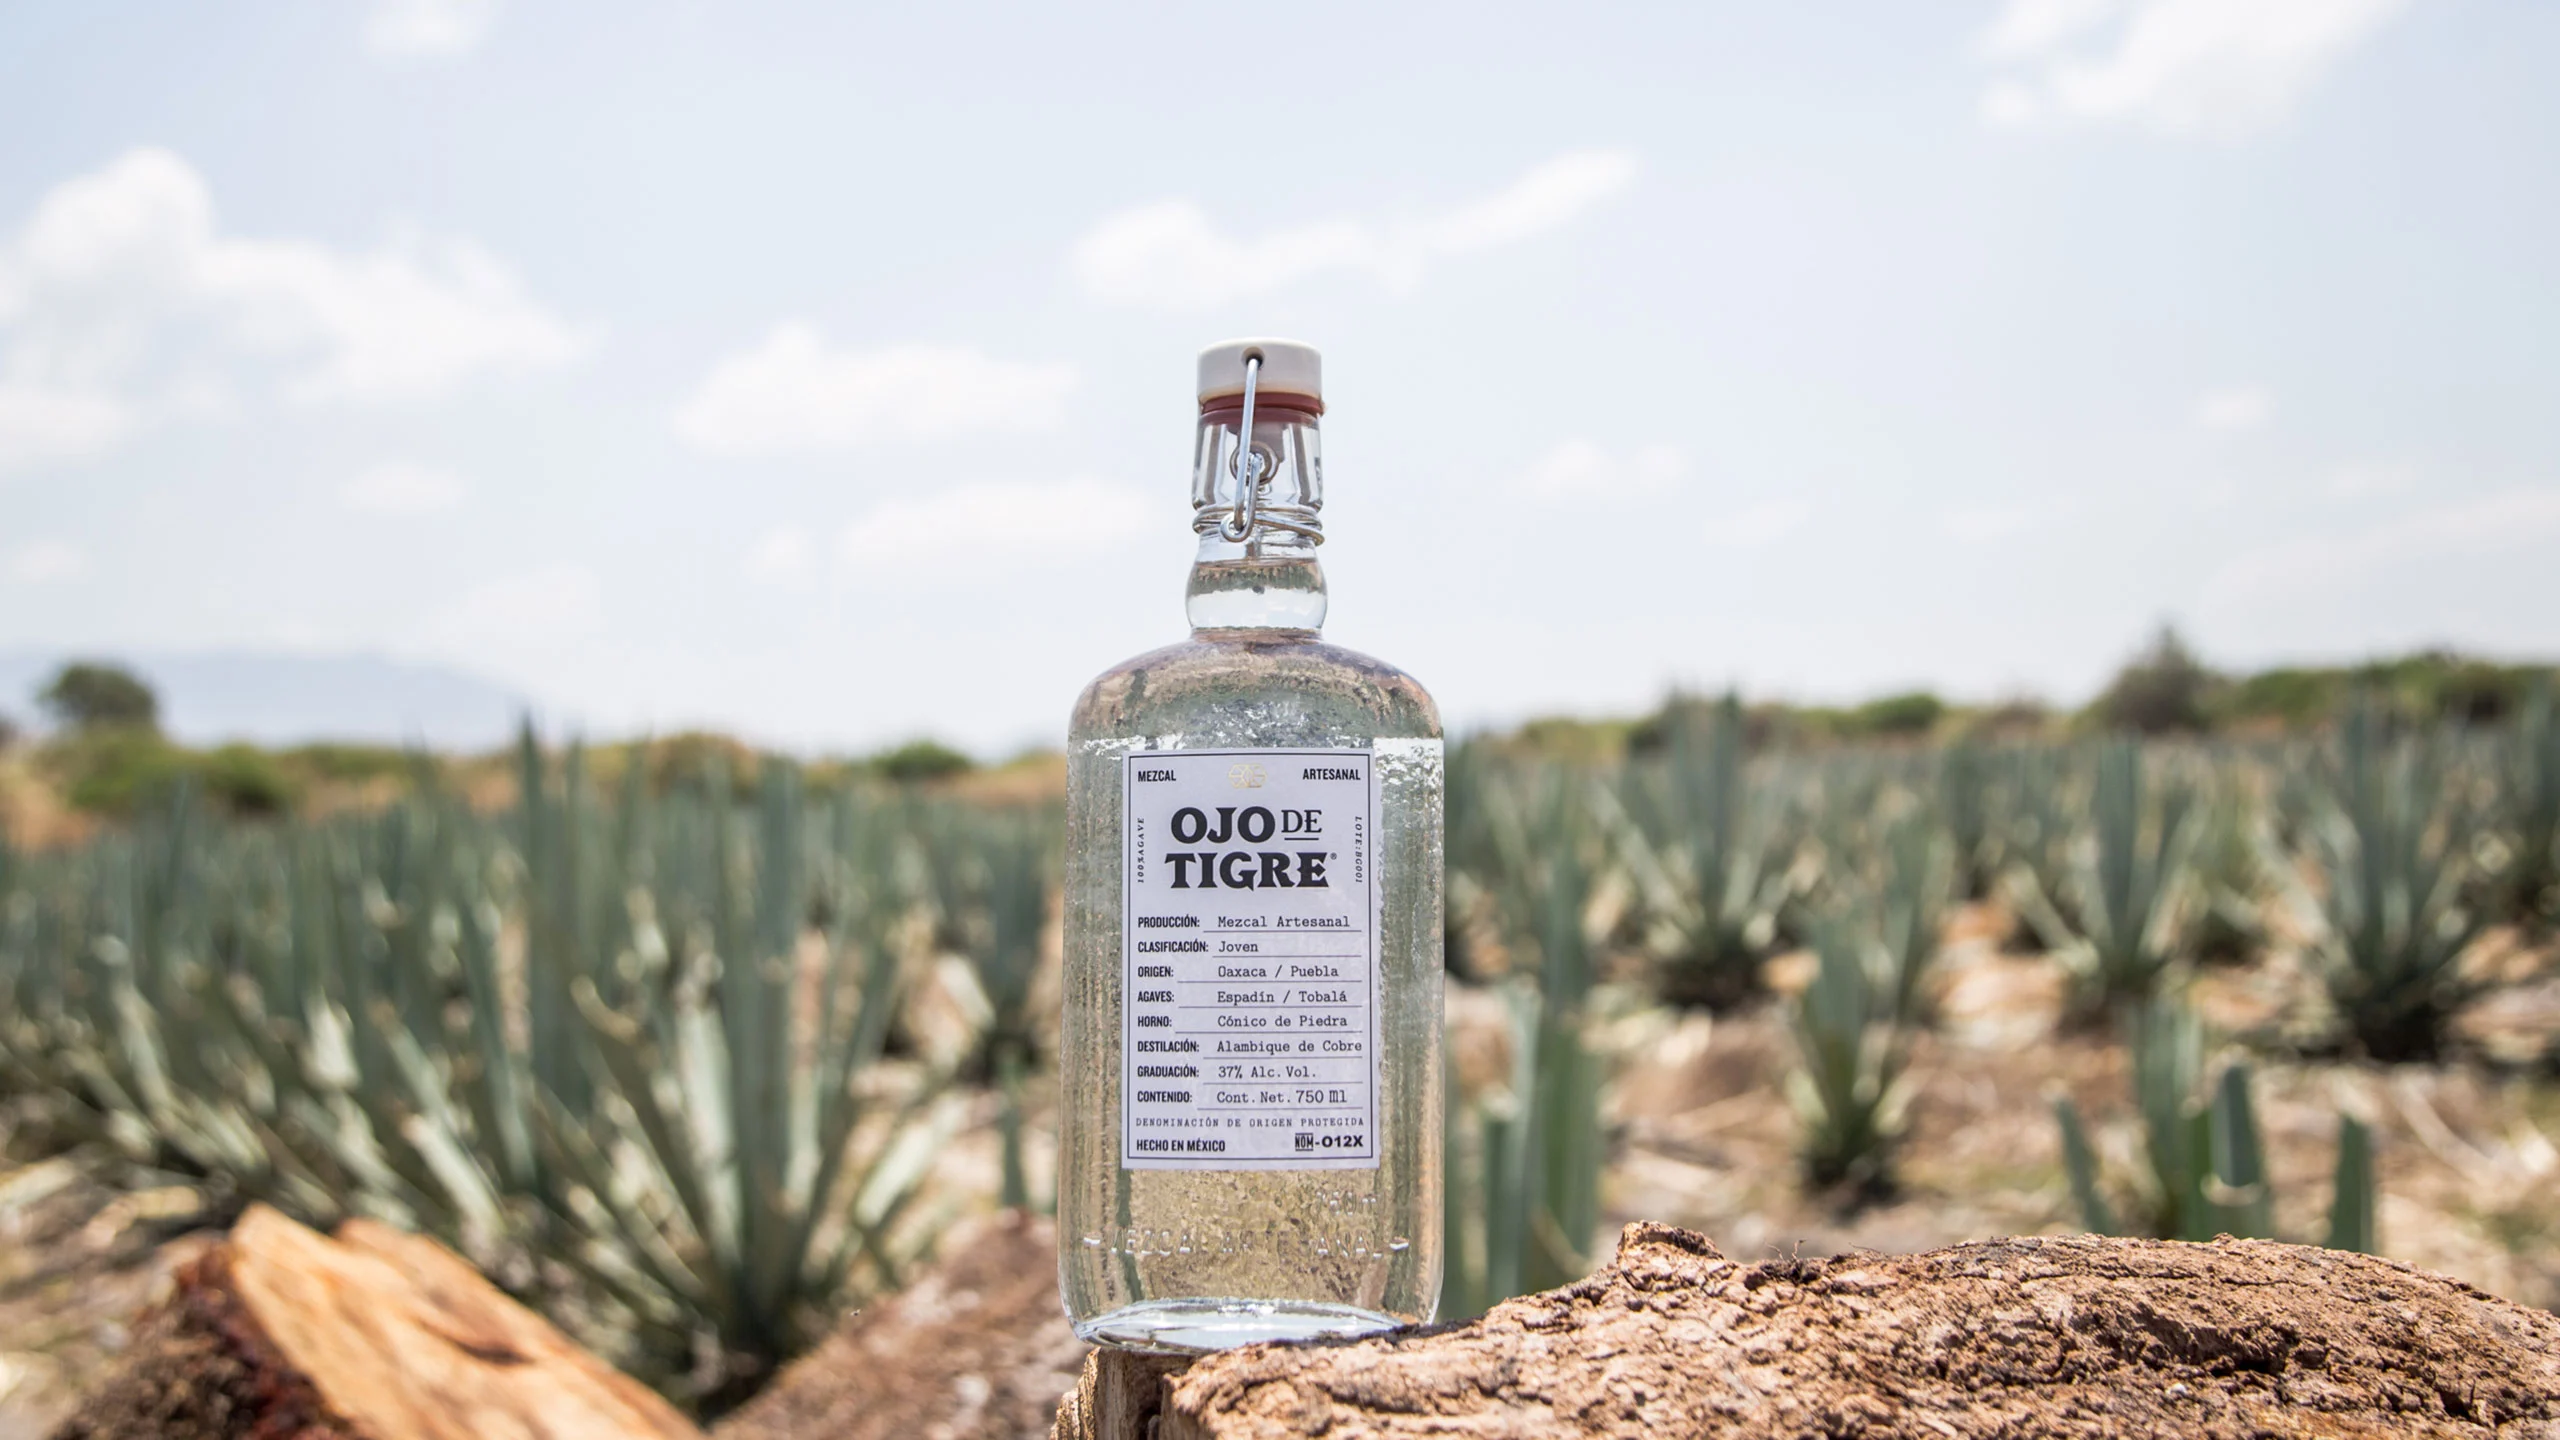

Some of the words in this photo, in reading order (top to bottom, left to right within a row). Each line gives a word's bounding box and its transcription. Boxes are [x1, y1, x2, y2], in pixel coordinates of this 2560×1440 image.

[1137, 769, 1177, 783] MEZCAL
[1302, 767, 1362, 782] ARTESANAL
[1170, 805, 1277, 845] OJO
[1280, 808, 1323, 835] DE
[1137, 914, 1201, 929] PRODUCCIÓN:
[1217, 915, 1269, 929] Mezcal
[1276, 915, 1352, 929] Artesanal
[1137, 938, 1210, 954] CLASIFICACIÓN:
[1218, 940, 1260, 954] Joven
[1137, 965, 1175, 979] ORIGEN:
[1217, 965, 1268, 979] Oaxaca
[1274, 964, 1284, 980] /
[1290, 965, 1340, 979] Puebla
[1137, 990, 1176, 1004] AGAVES:
[1216, 990, 1276, 1007] Espadín
[1282, 989, 1292, 1005] /
[1298, 989, 1349, 1004] Tobalá
[1137, 1015, 1174, 1029] HORNO:
[1217, 1014, 1268, 1029] Cónico
[1273, 1014, 1293, 1029] de
[1299, 1014, 1349, 1029] Piedra
[1137, 1038, 1201, 1054] DESTILACIÓN:
[1216, 1039, 1292, 1057] Alambique
[1297, 1039, 1316, 1053] de
[1322, 1039, 1364, 1053] Cobre
[1136, 1063, 1201, 1079] GRADUACIÓN:
[1217, 1065, 1245, 1080] 37%
[1136, 1090, 1194, 1104] CONTENIDO:
[1135, 1116, 1220, 1129] DENOMINACIÓN
[1226, 1117, 1243, 1128] DE
[1248, 1117, 1293, 1128] ORIGEN
[1300, 1117, 1365, 1128] PROTEGIDA
[1136, 1138, 1169, 1153] HECHO
[1171, 1138, 1185, 1153] EN
[1186, 1136, 1227, 1153] MÉXICO
